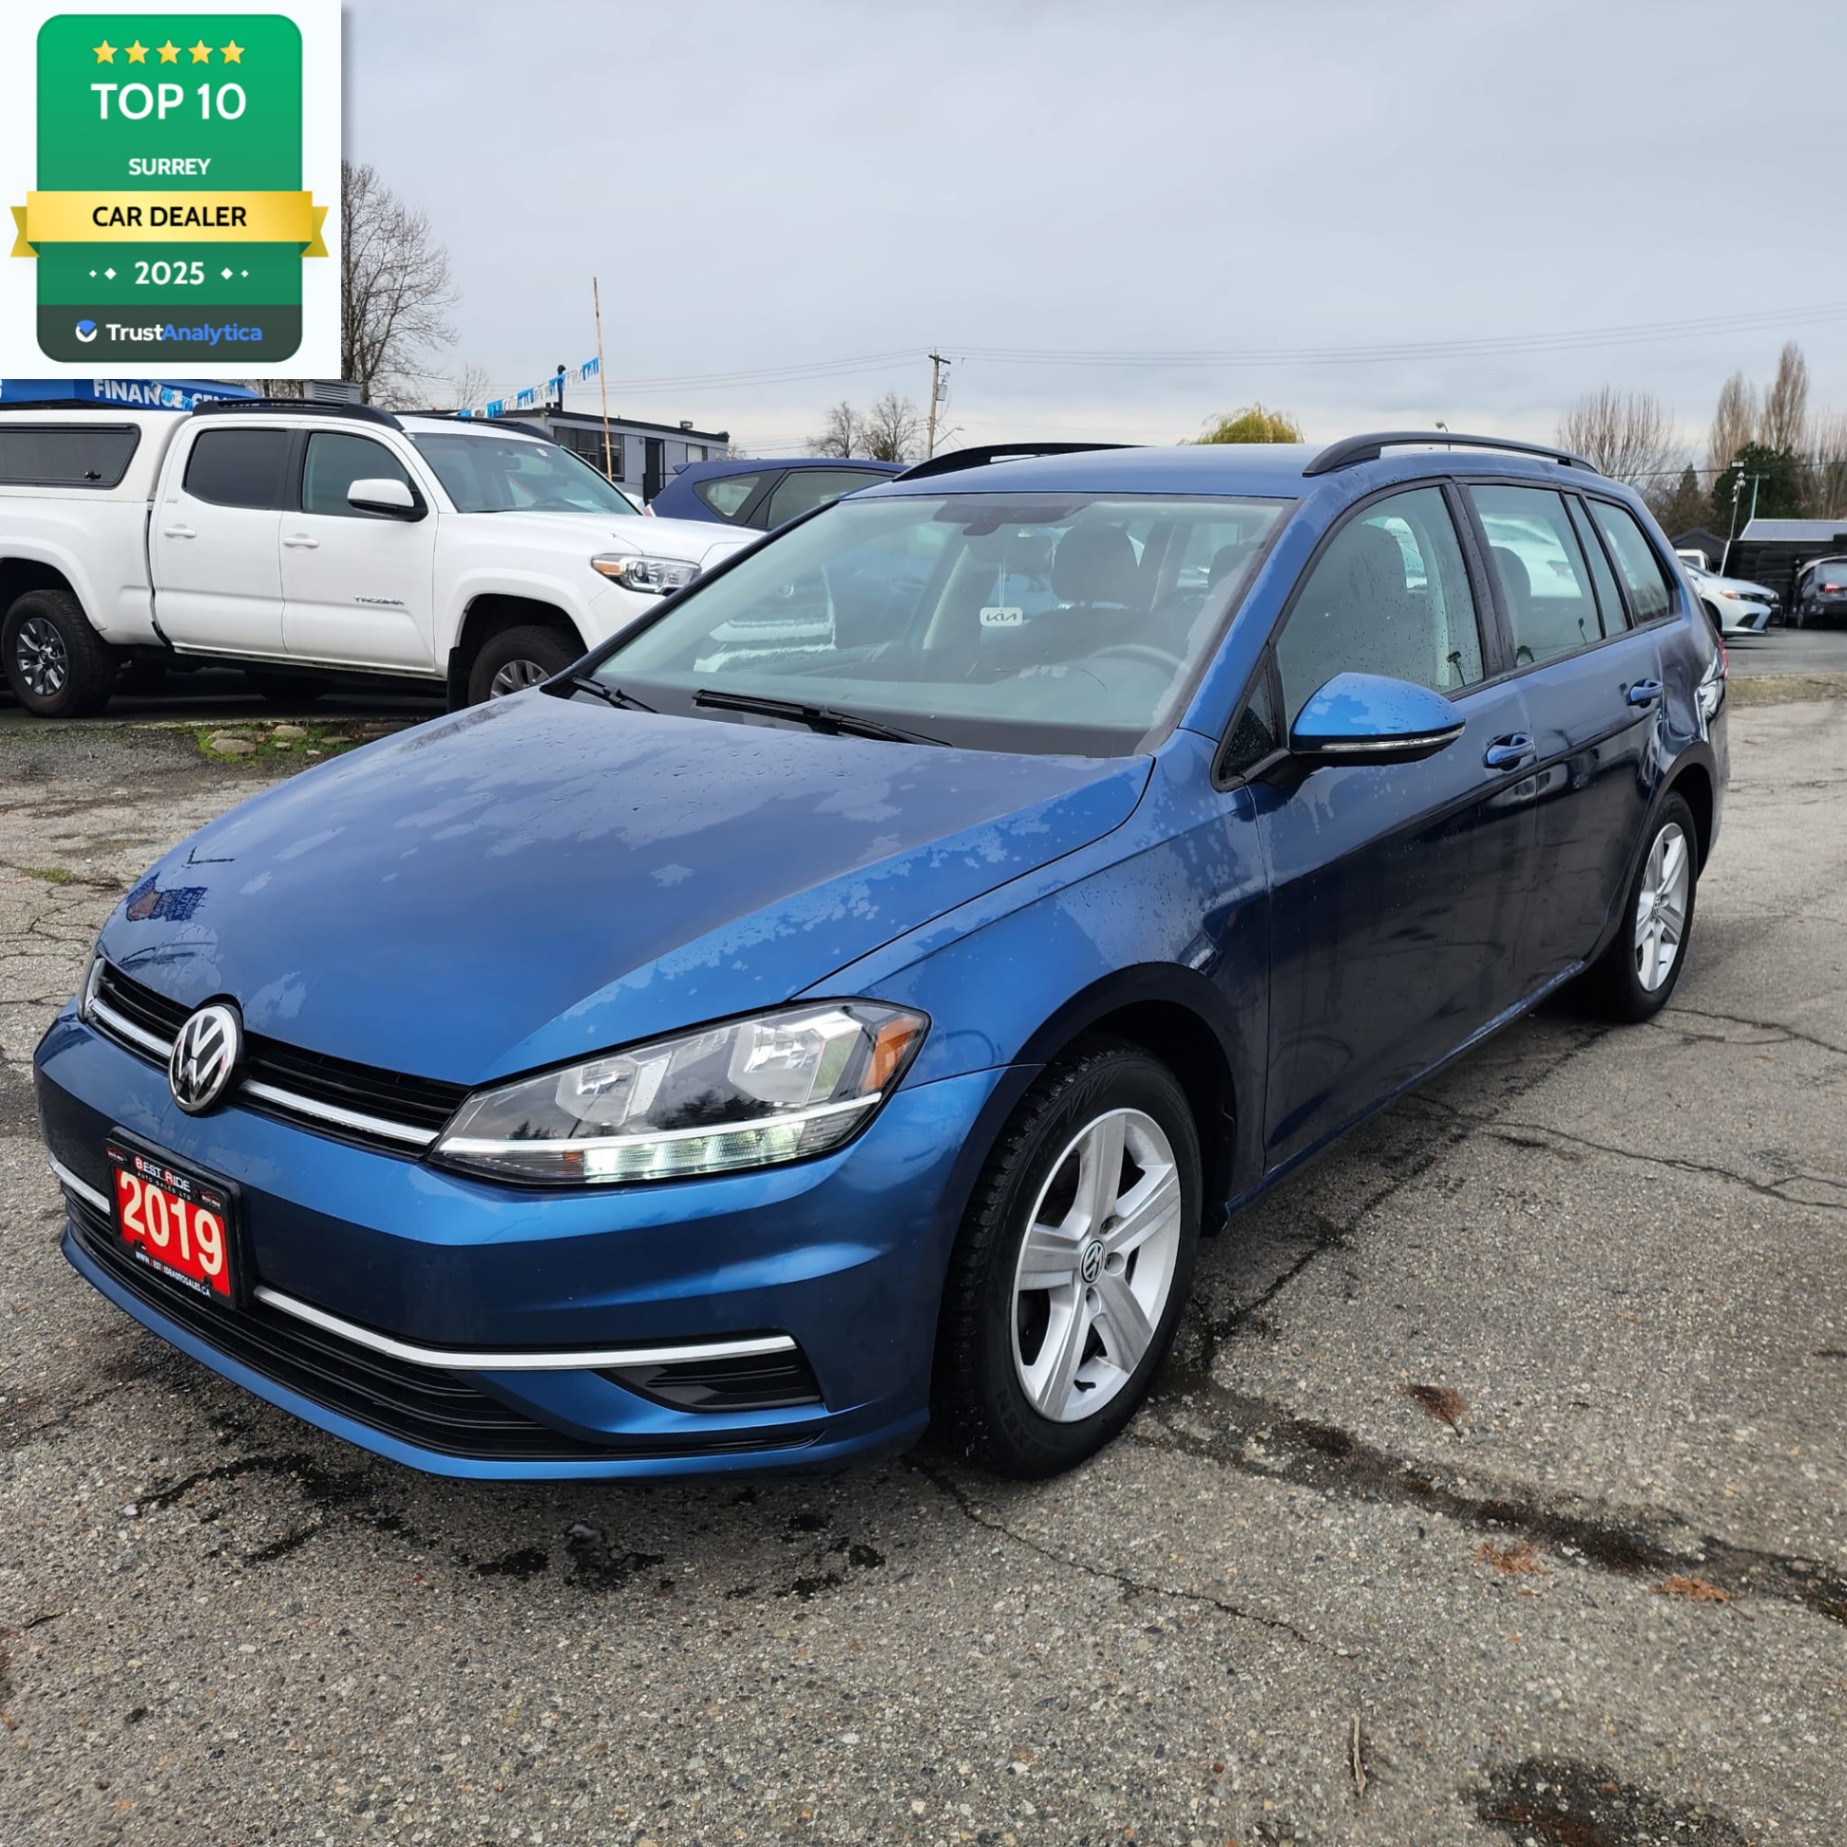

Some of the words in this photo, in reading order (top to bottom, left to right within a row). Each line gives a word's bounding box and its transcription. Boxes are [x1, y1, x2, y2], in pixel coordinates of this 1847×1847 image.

[986, 613, 1017, 621] KIA
[135, 1156, 161, 1178] BEST
[164, 1169, 191, 1193] RIDE
[121, 1171, 223, 1276] 2019
